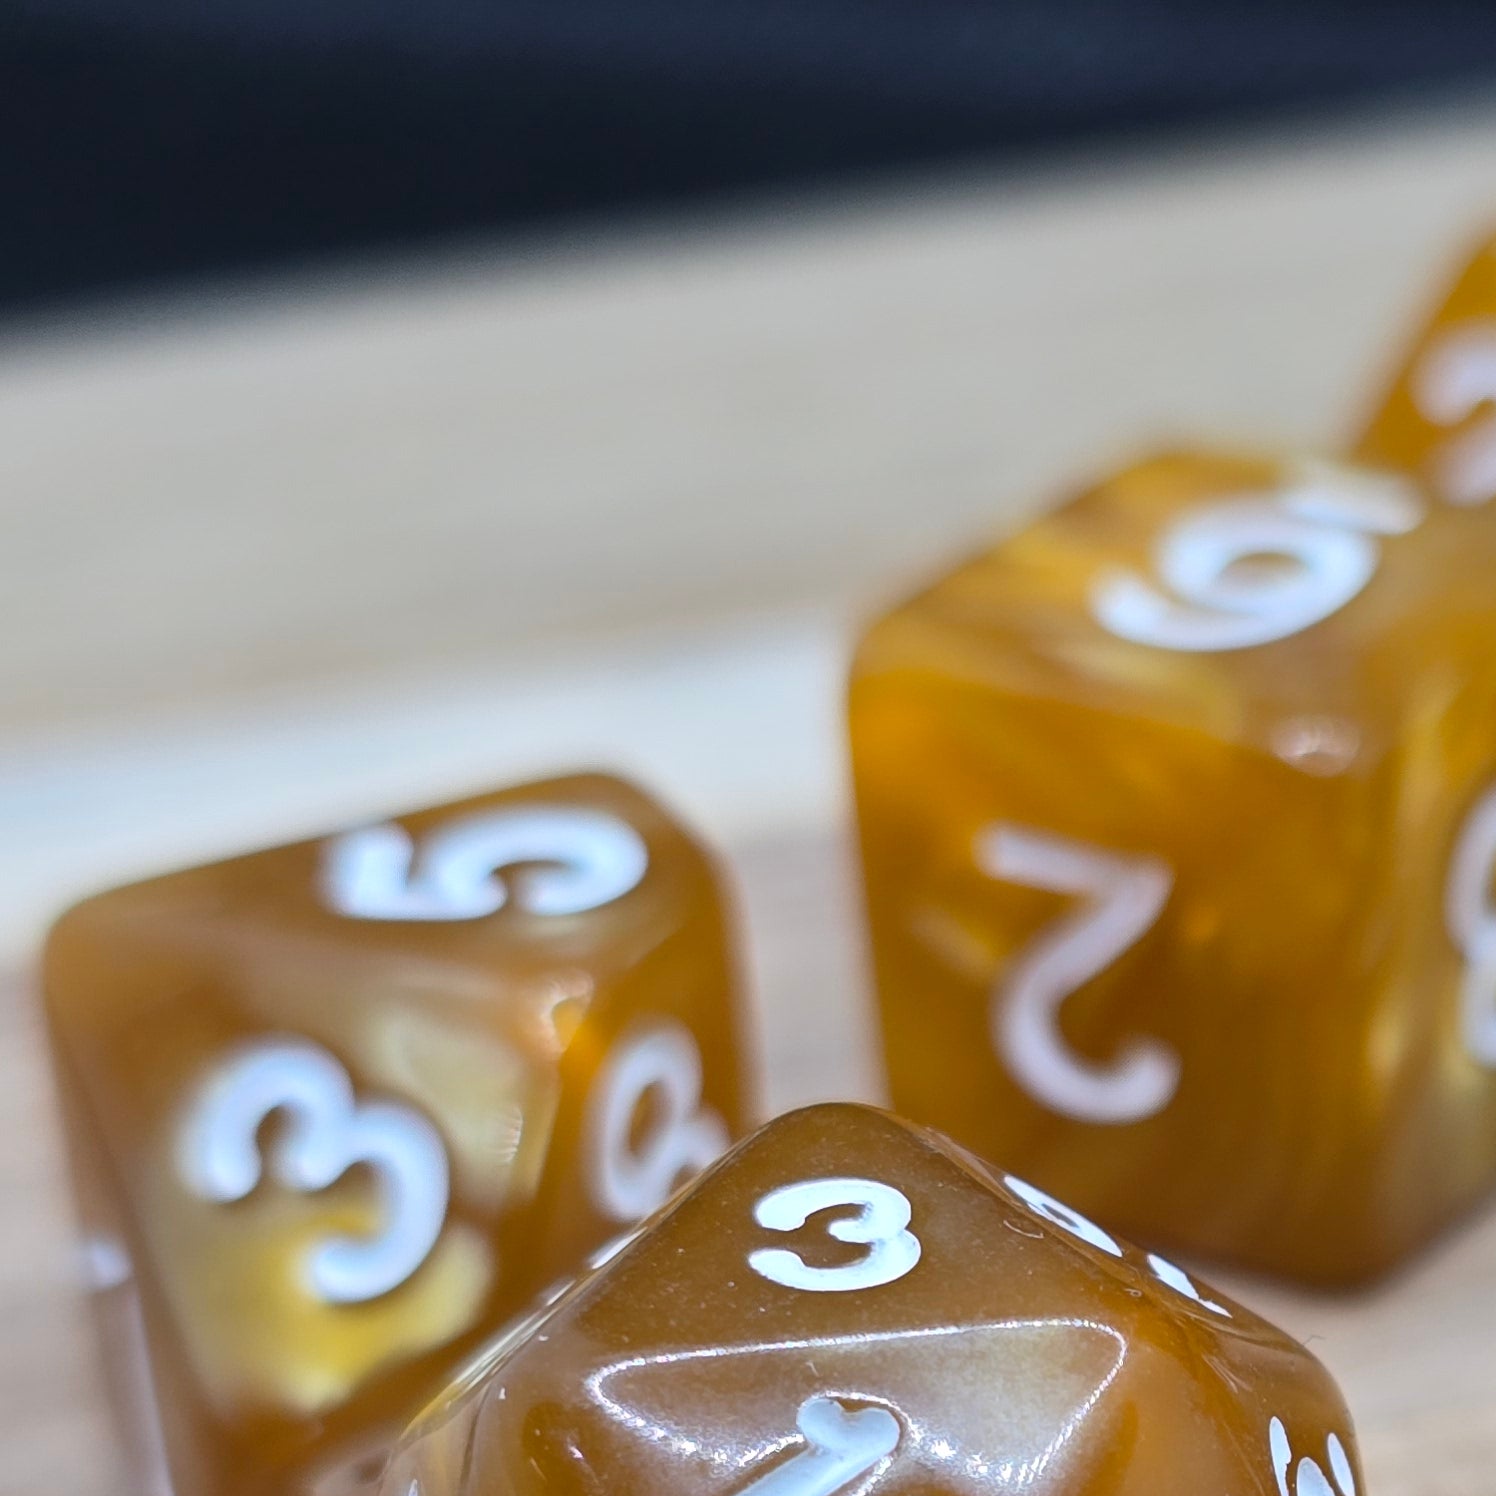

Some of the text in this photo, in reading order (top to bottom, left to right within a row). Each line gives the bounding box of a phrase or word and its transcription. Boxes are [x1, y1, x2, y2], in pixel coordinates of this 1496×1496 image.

[330, 808, 650, 922] 5
[974, 820, 1182, 1124] 2
[185, 1040, 450, 1304] 3
[748, 1177, 922, 1292] 3
